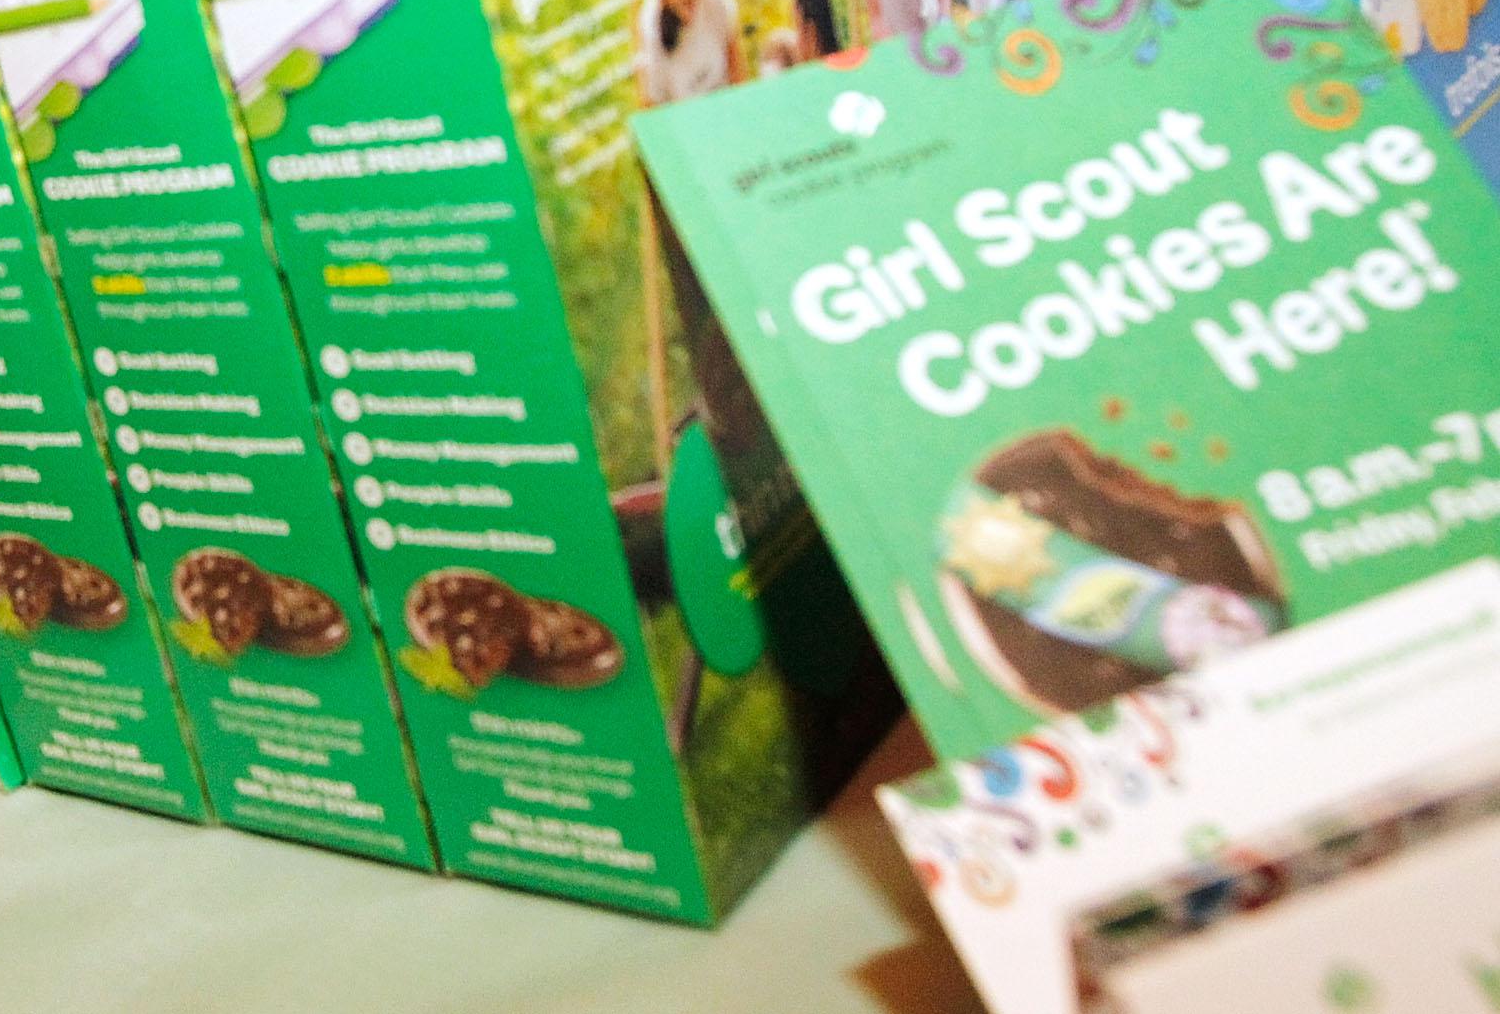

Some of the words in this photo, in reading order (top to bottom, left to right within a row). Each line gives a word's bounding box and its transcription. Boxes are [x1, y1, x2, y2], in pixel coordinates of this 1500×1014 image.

[790, 218, 965, 344] Girl
[955, 108, 1232, 268] Scout
[898, 199, 1272, 415] Cookies
[1258, 124, 1438, 242] Are
[1256, 470, 1313, 522] 8
